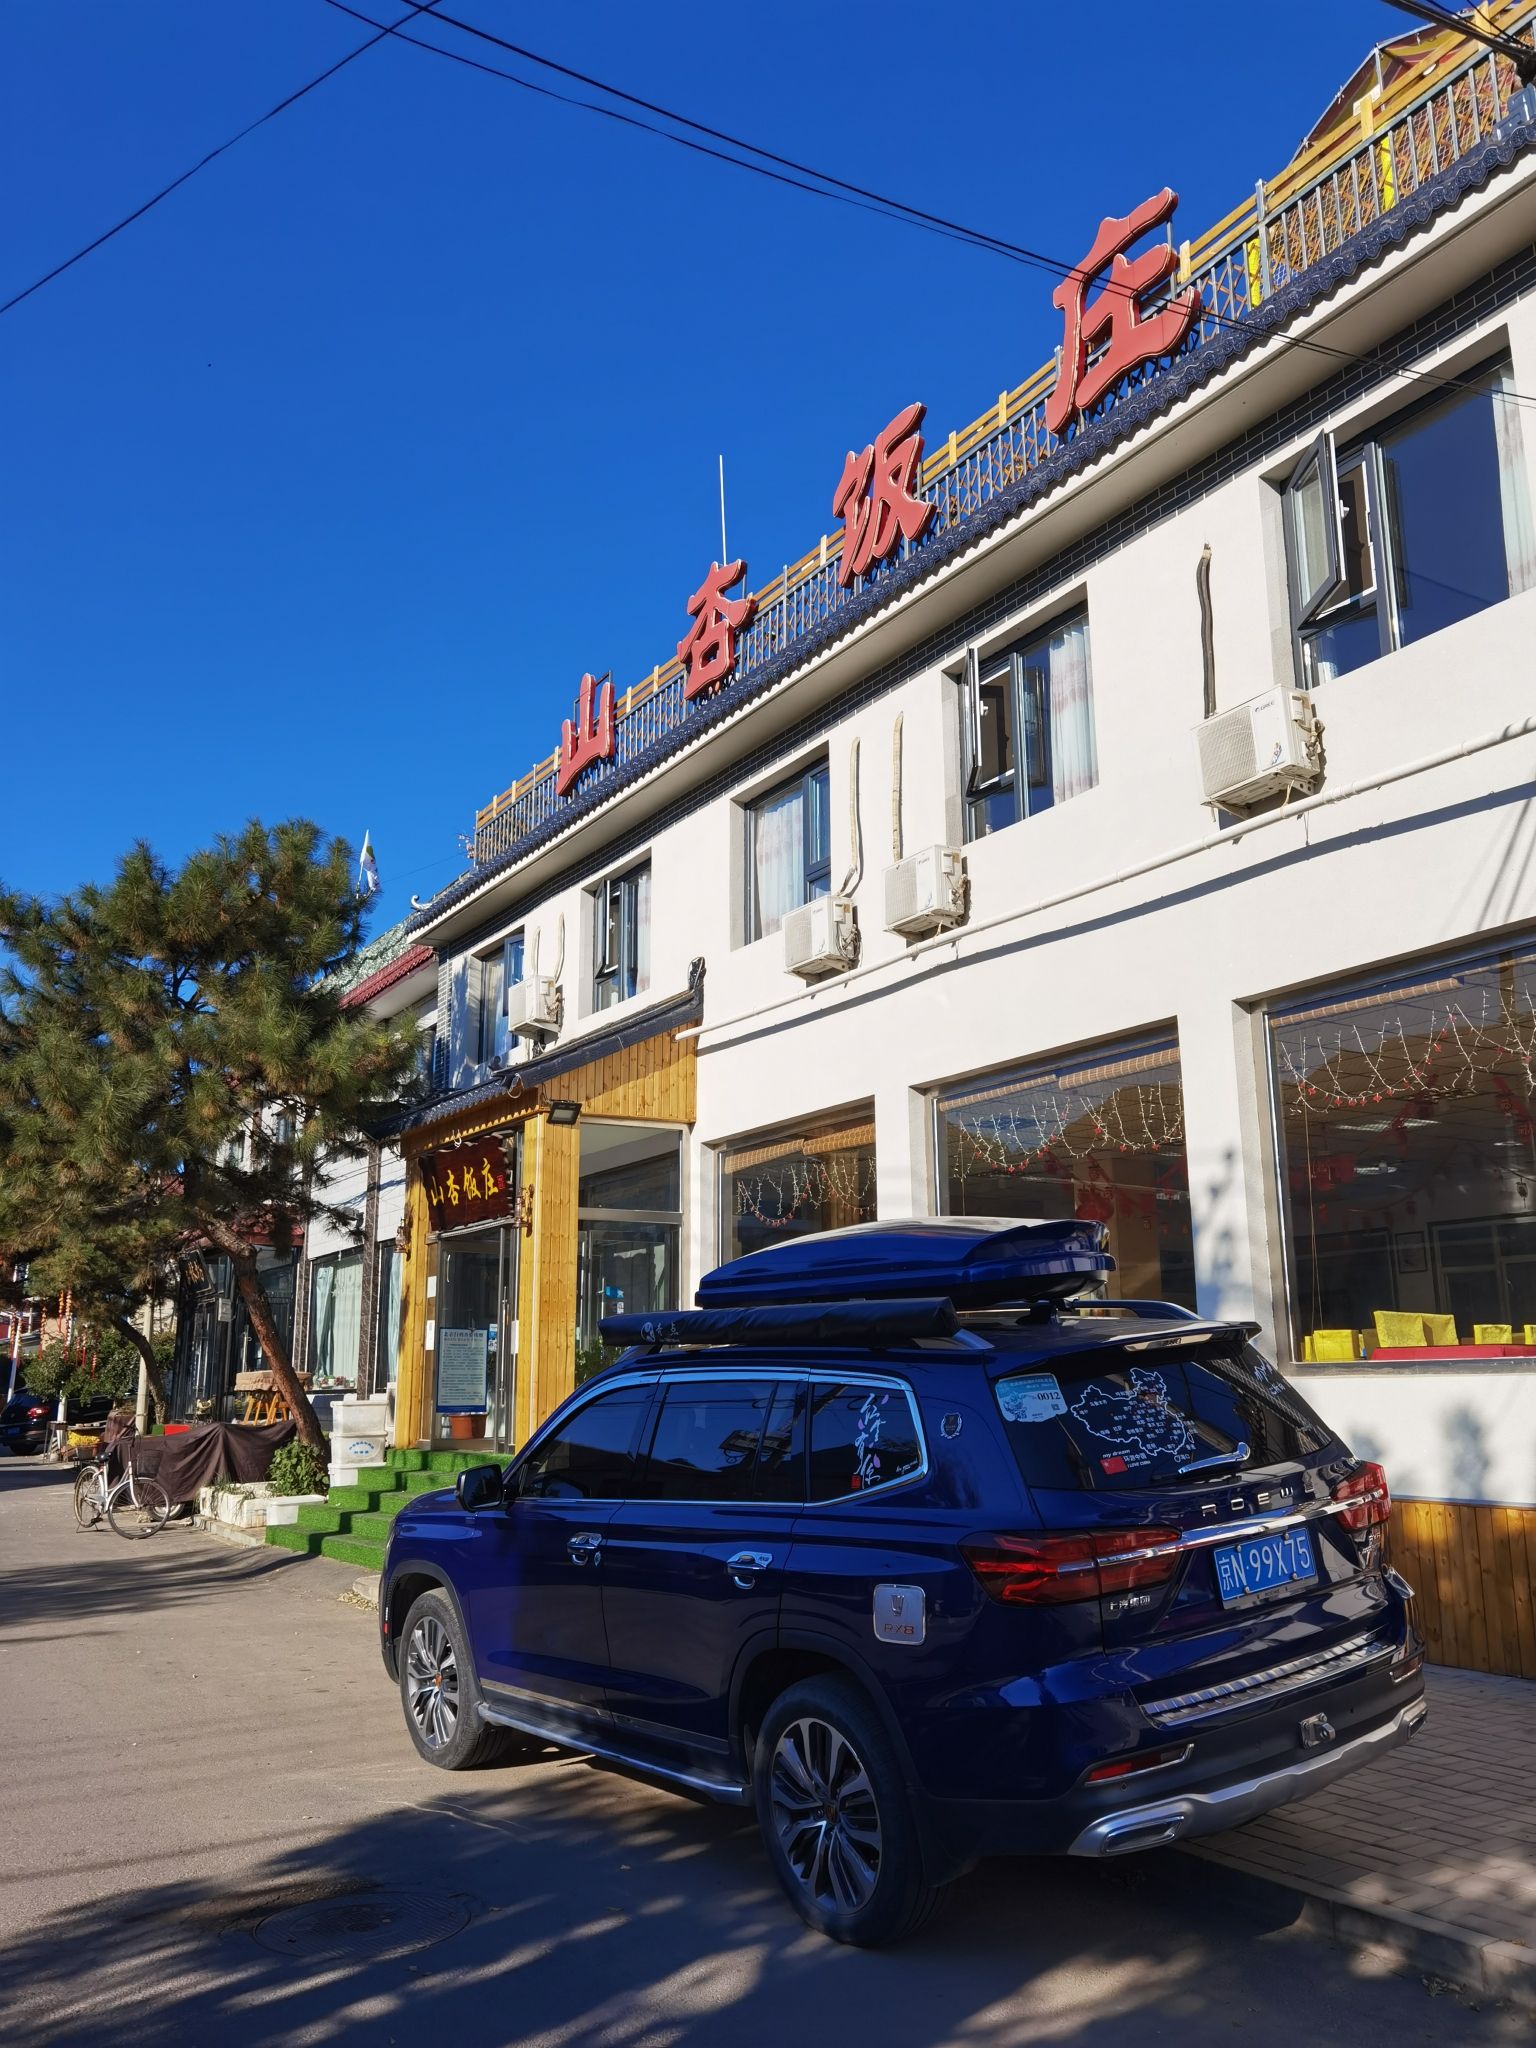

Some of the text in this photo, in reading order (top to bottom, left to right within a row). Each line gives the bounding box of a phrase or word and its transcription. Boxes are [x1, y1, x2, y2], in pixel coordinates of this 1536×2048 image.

[555, 186, 1200, 797] 山杏饭庄
[430, 1157, 499, 1207] 山杏饭庄
[1036, 1391, 1061, 1401] 0012
[884, 1623, 914, 1635] RX8
